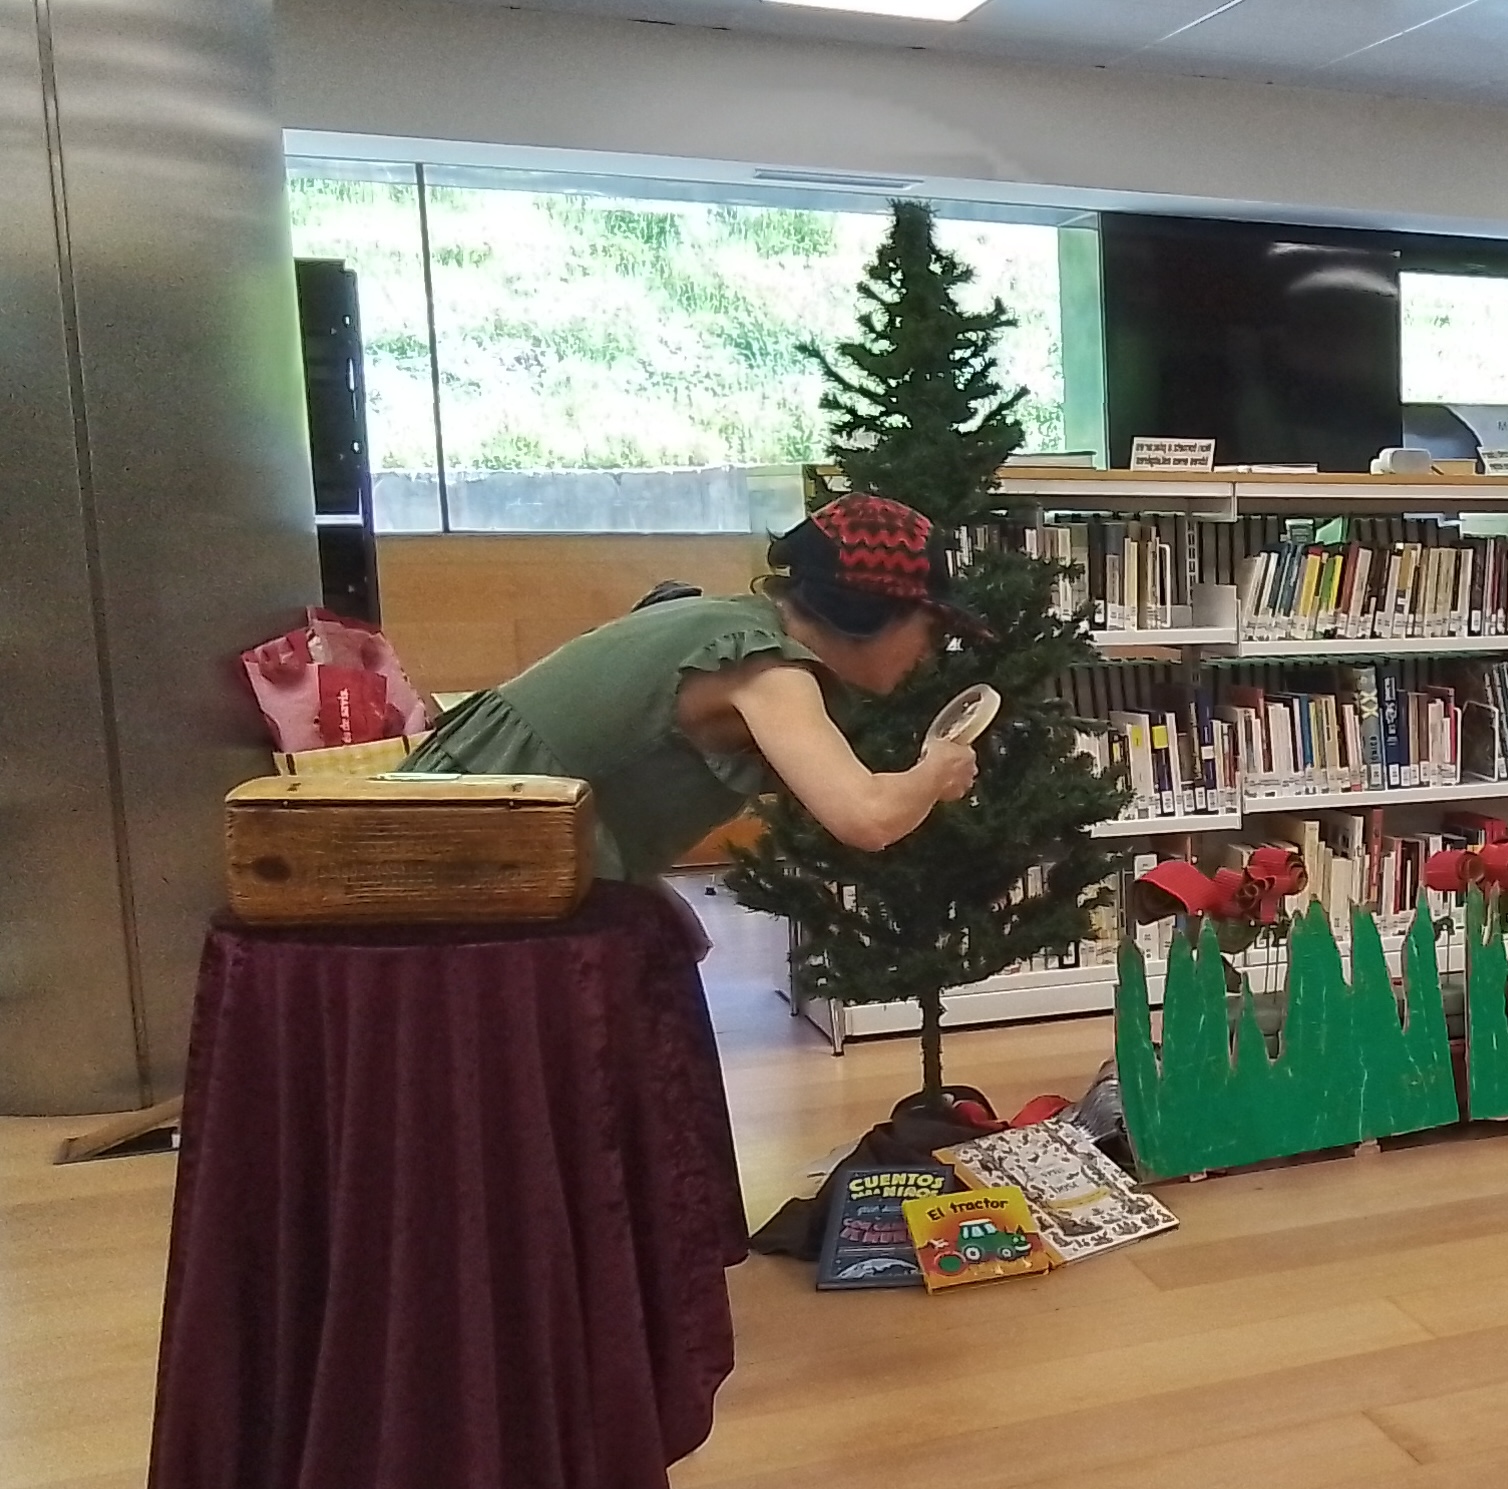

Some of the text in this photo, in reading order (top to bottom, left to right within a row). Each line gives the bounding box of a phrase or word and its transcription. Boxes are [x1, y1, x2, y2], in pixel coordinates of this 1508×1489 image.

[849, 1173, 945, 1192] CUENTOS
[926, 1197, 1009, 1221] El tractor
